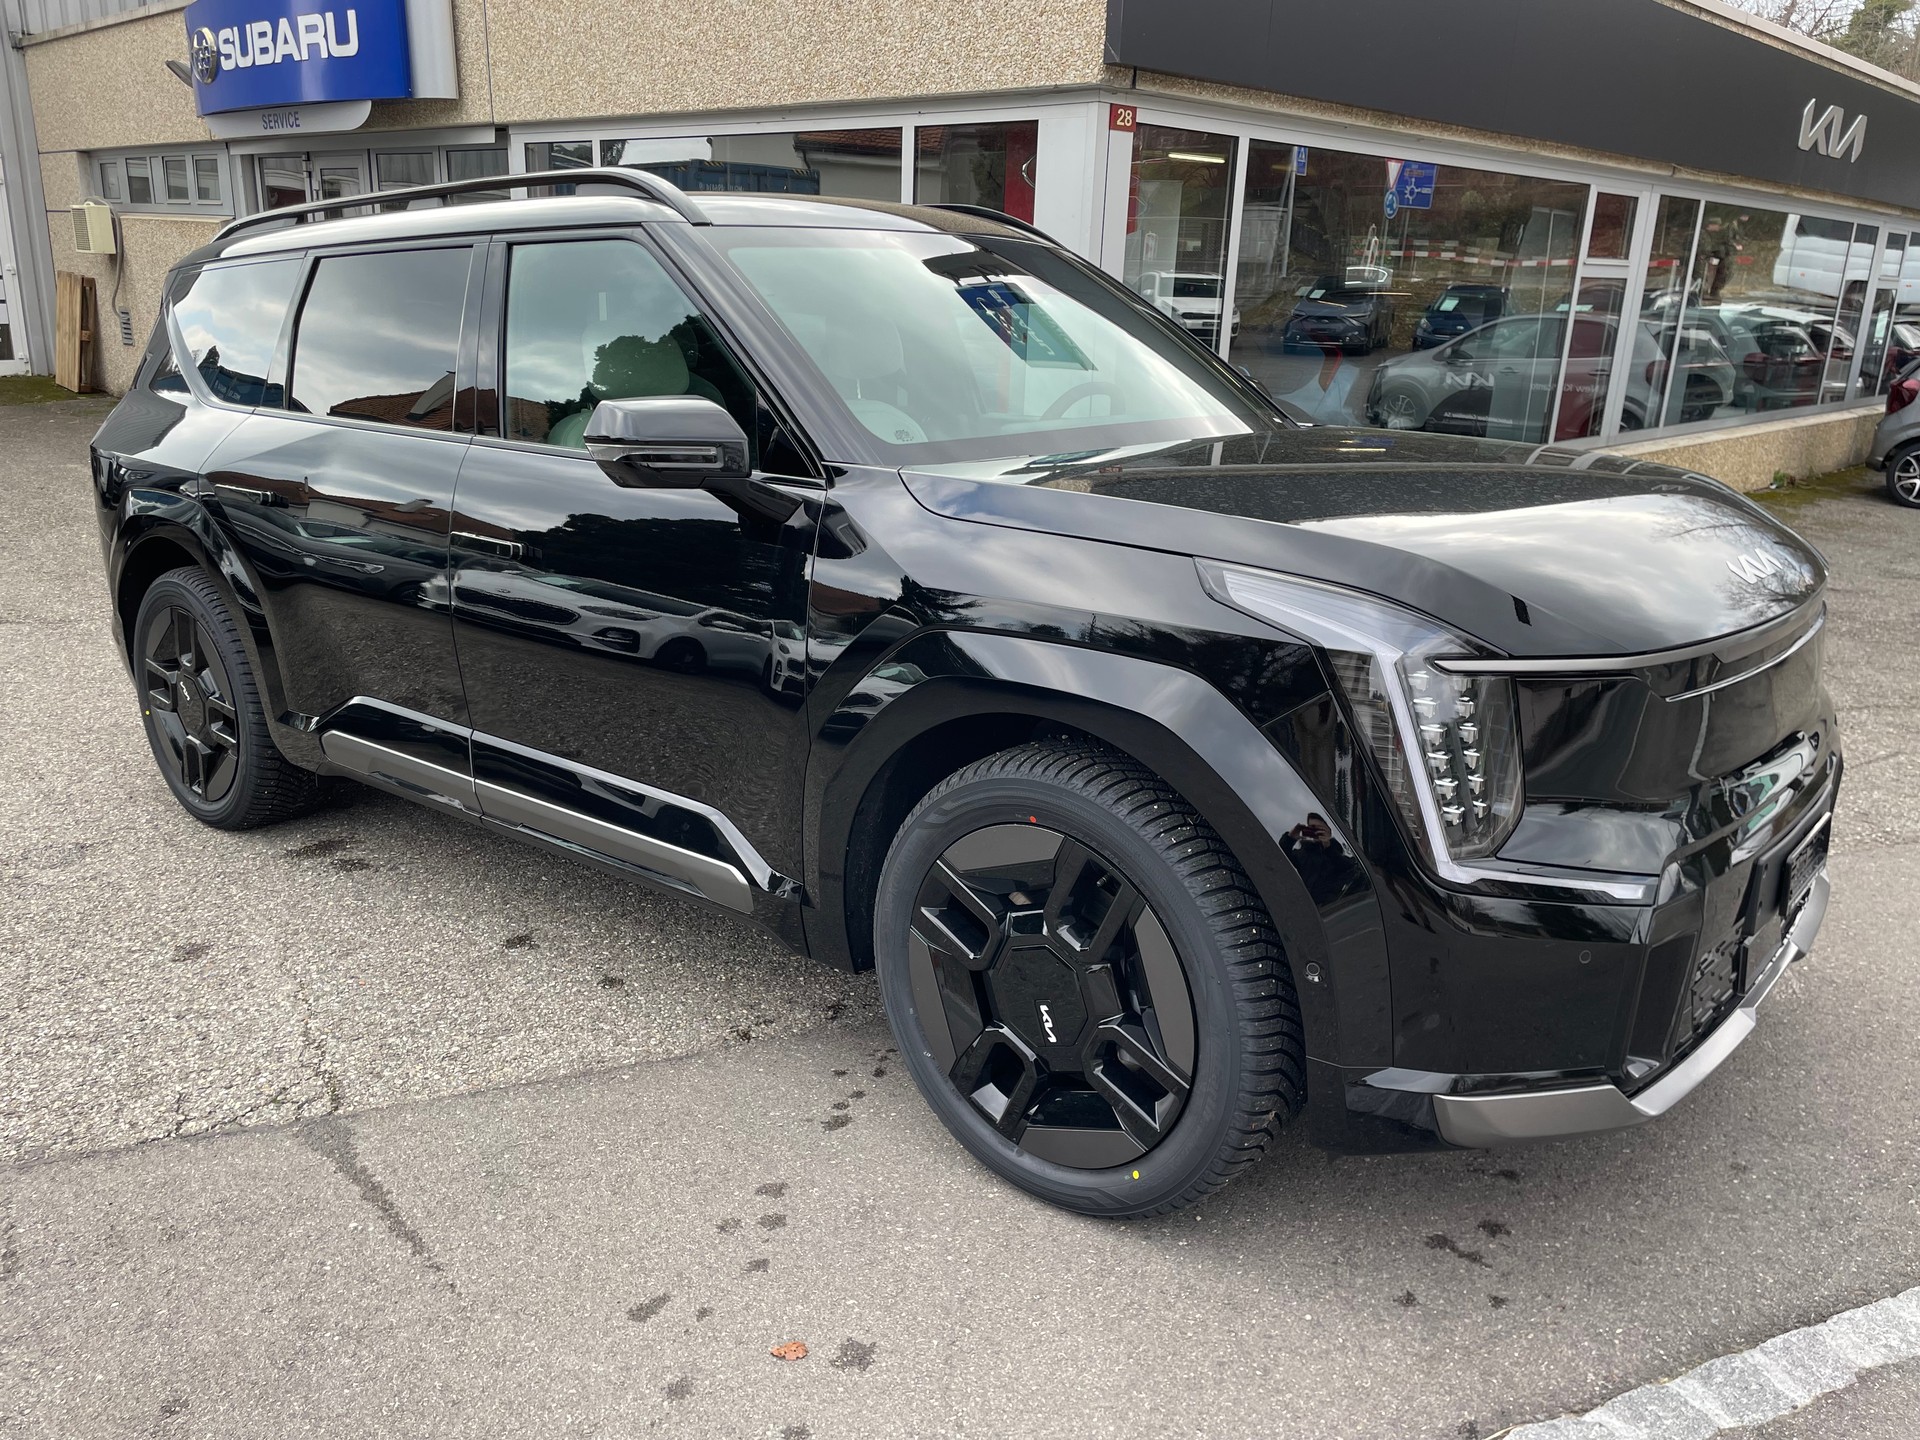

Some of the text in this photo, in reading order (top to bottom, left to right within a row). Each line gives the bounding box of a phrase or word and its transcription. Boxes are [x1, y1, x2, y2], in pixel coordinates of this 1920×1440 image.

[218, 9, 359, 71] SUBARU
[261, 111, 301, 130] SERVICE
[1116, 108, 1133, 127] 28
[1798, 98, 1868, 163] KIA
[1040, 1005, 1057, 1042] KIA
